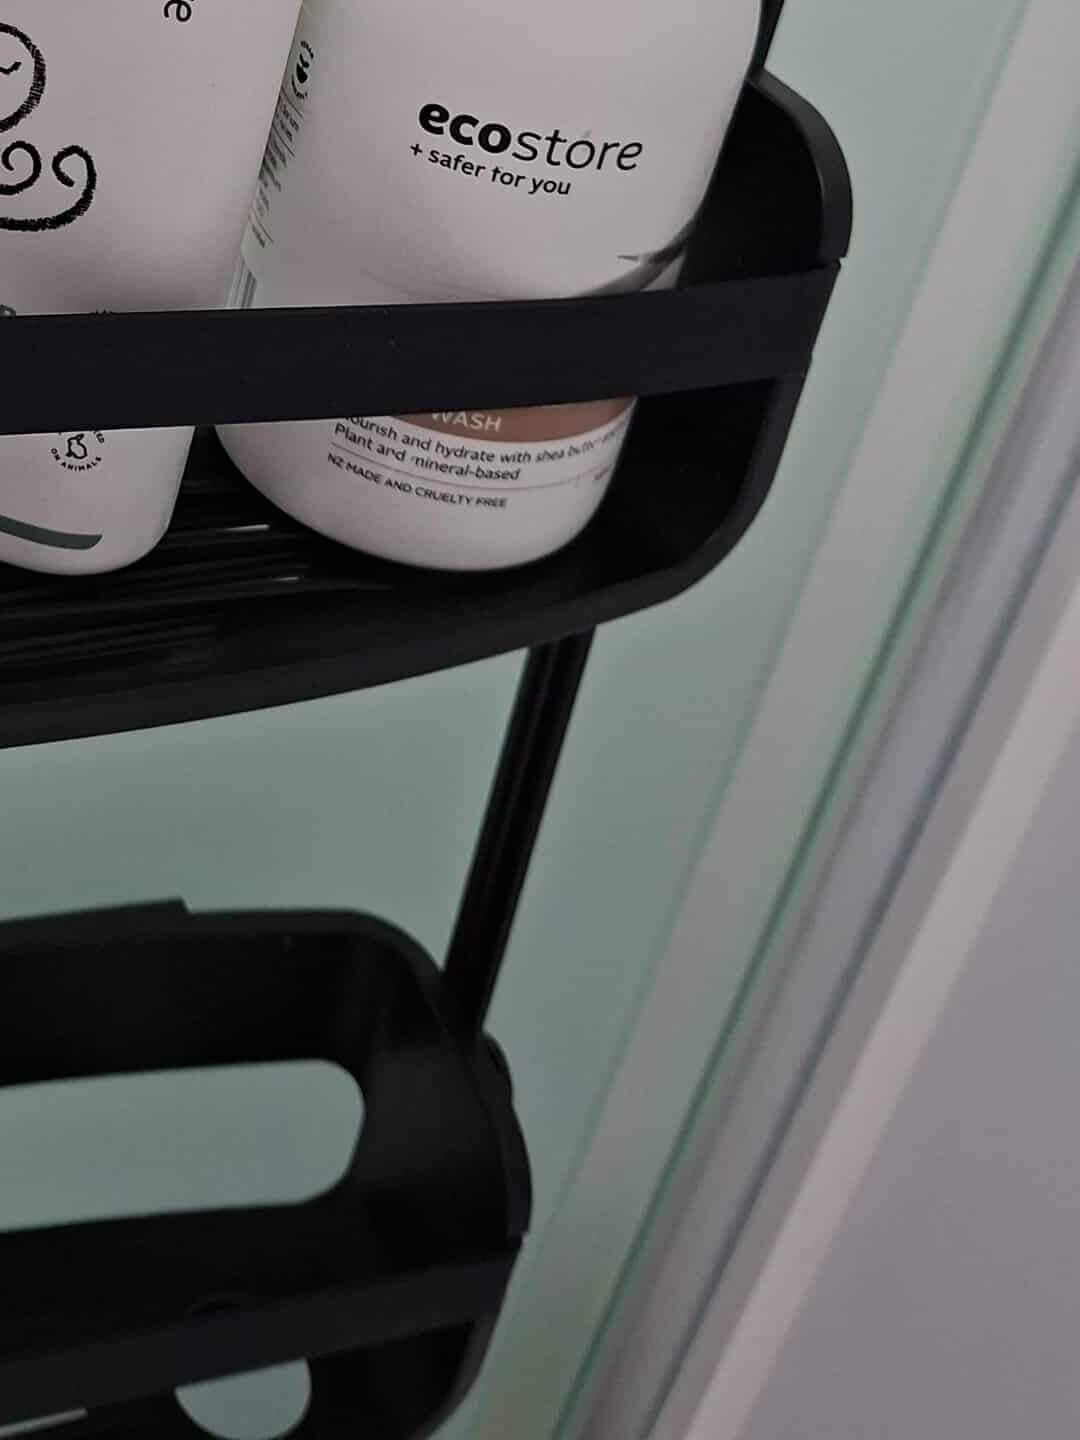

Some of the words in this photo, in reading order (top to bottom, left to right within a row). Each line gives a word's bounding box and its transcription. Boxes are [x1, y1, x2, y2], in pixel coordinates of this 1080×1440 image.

[419, 103, 643, 171] ecostore
[428, 149, 486, 177] safer
[491, 166, 526, 188] for
[528, 177, 571, 195] you
[334, 422, 373, 451] Plant
[376, 444, 407, 462] and
[401, 434, 431, 451] and
[434, 440, 495, 463] hydrate
[500, 450, 531, 464] with
[383, 477, 412, 494] AND
[415, 485, 472, 505] CRUELTY
